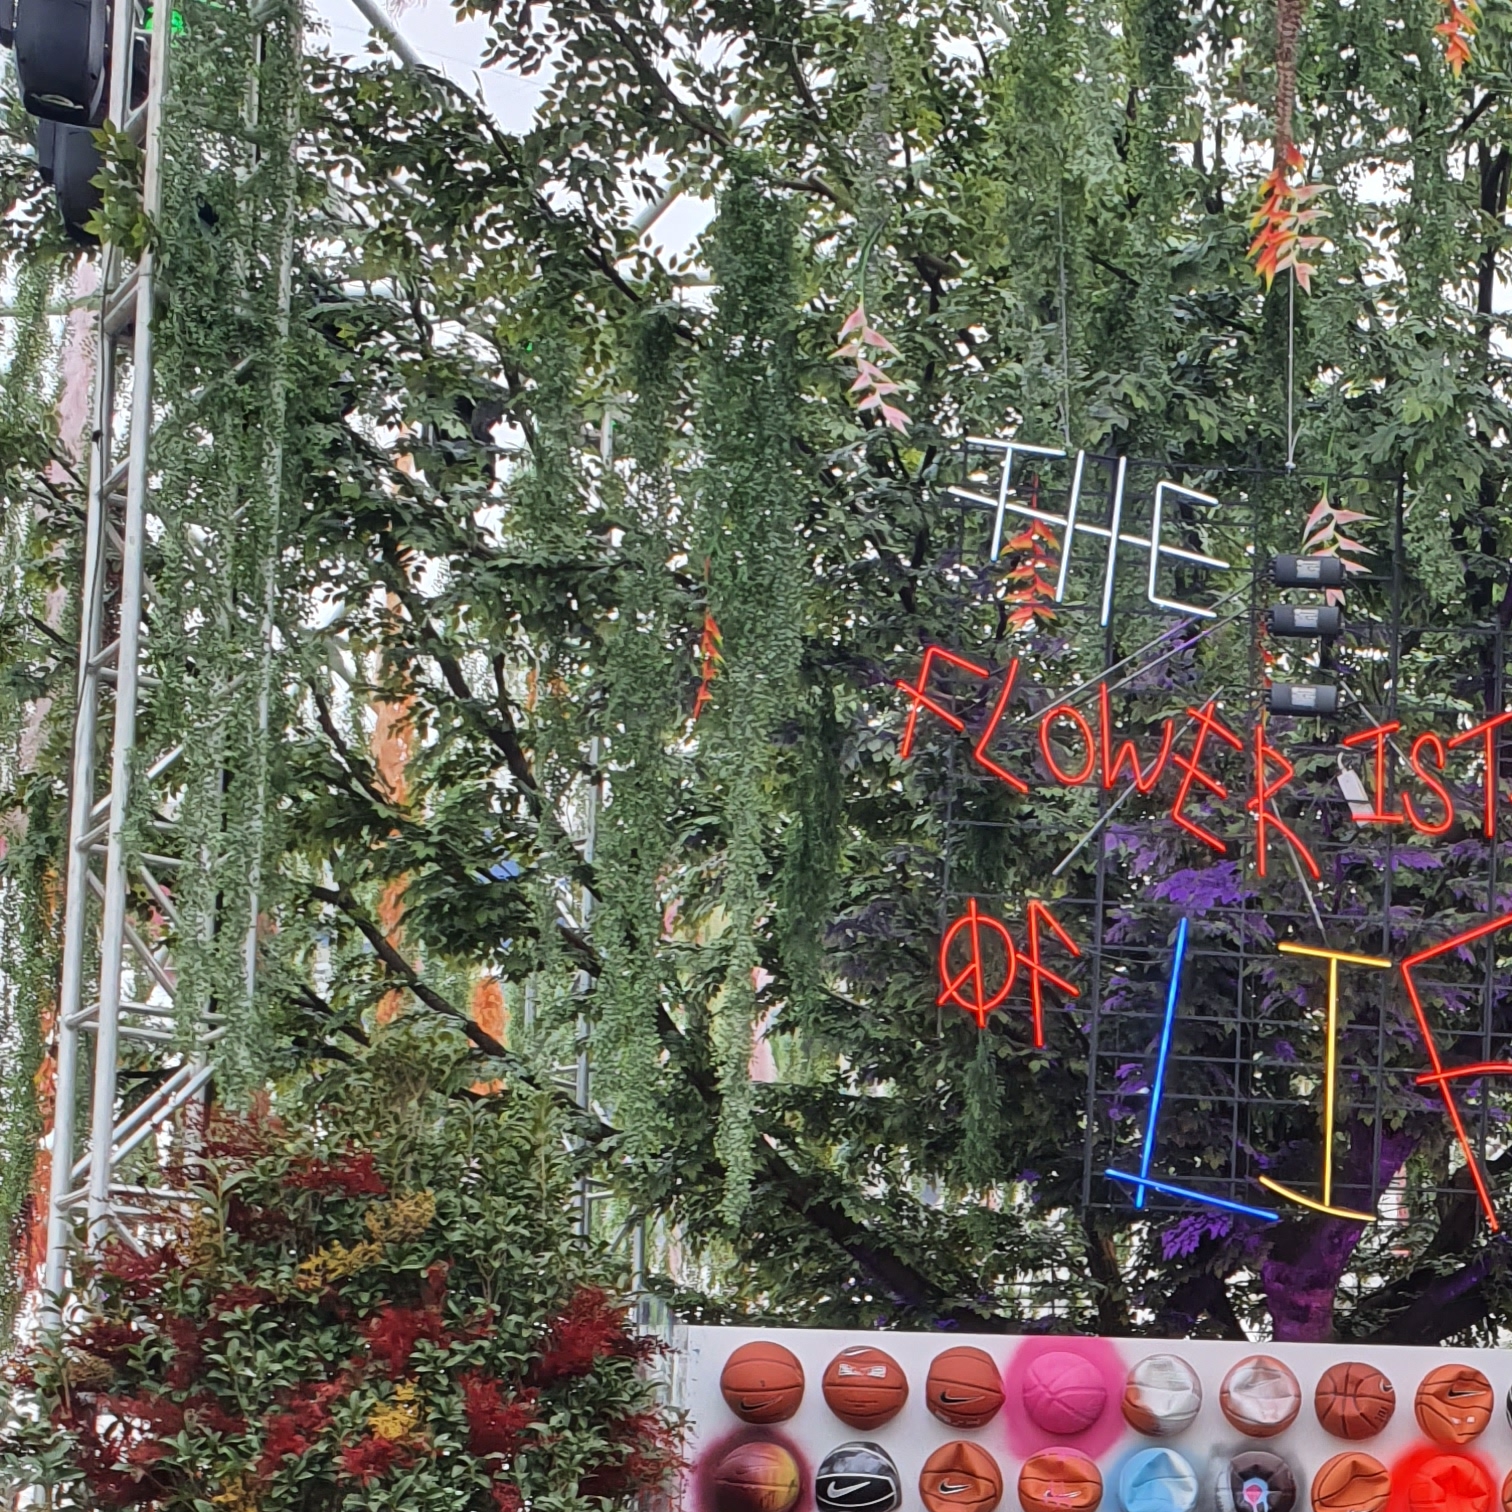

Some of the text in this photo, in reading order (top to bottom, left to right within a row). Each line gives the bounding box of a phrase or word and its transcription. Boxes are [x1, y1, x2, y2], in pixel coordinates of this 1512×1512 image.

[948, 436, 1231, 627] THE
[896, 646, 1321, 879] FLOWER
[1343, 721, 1454, 836] IS
